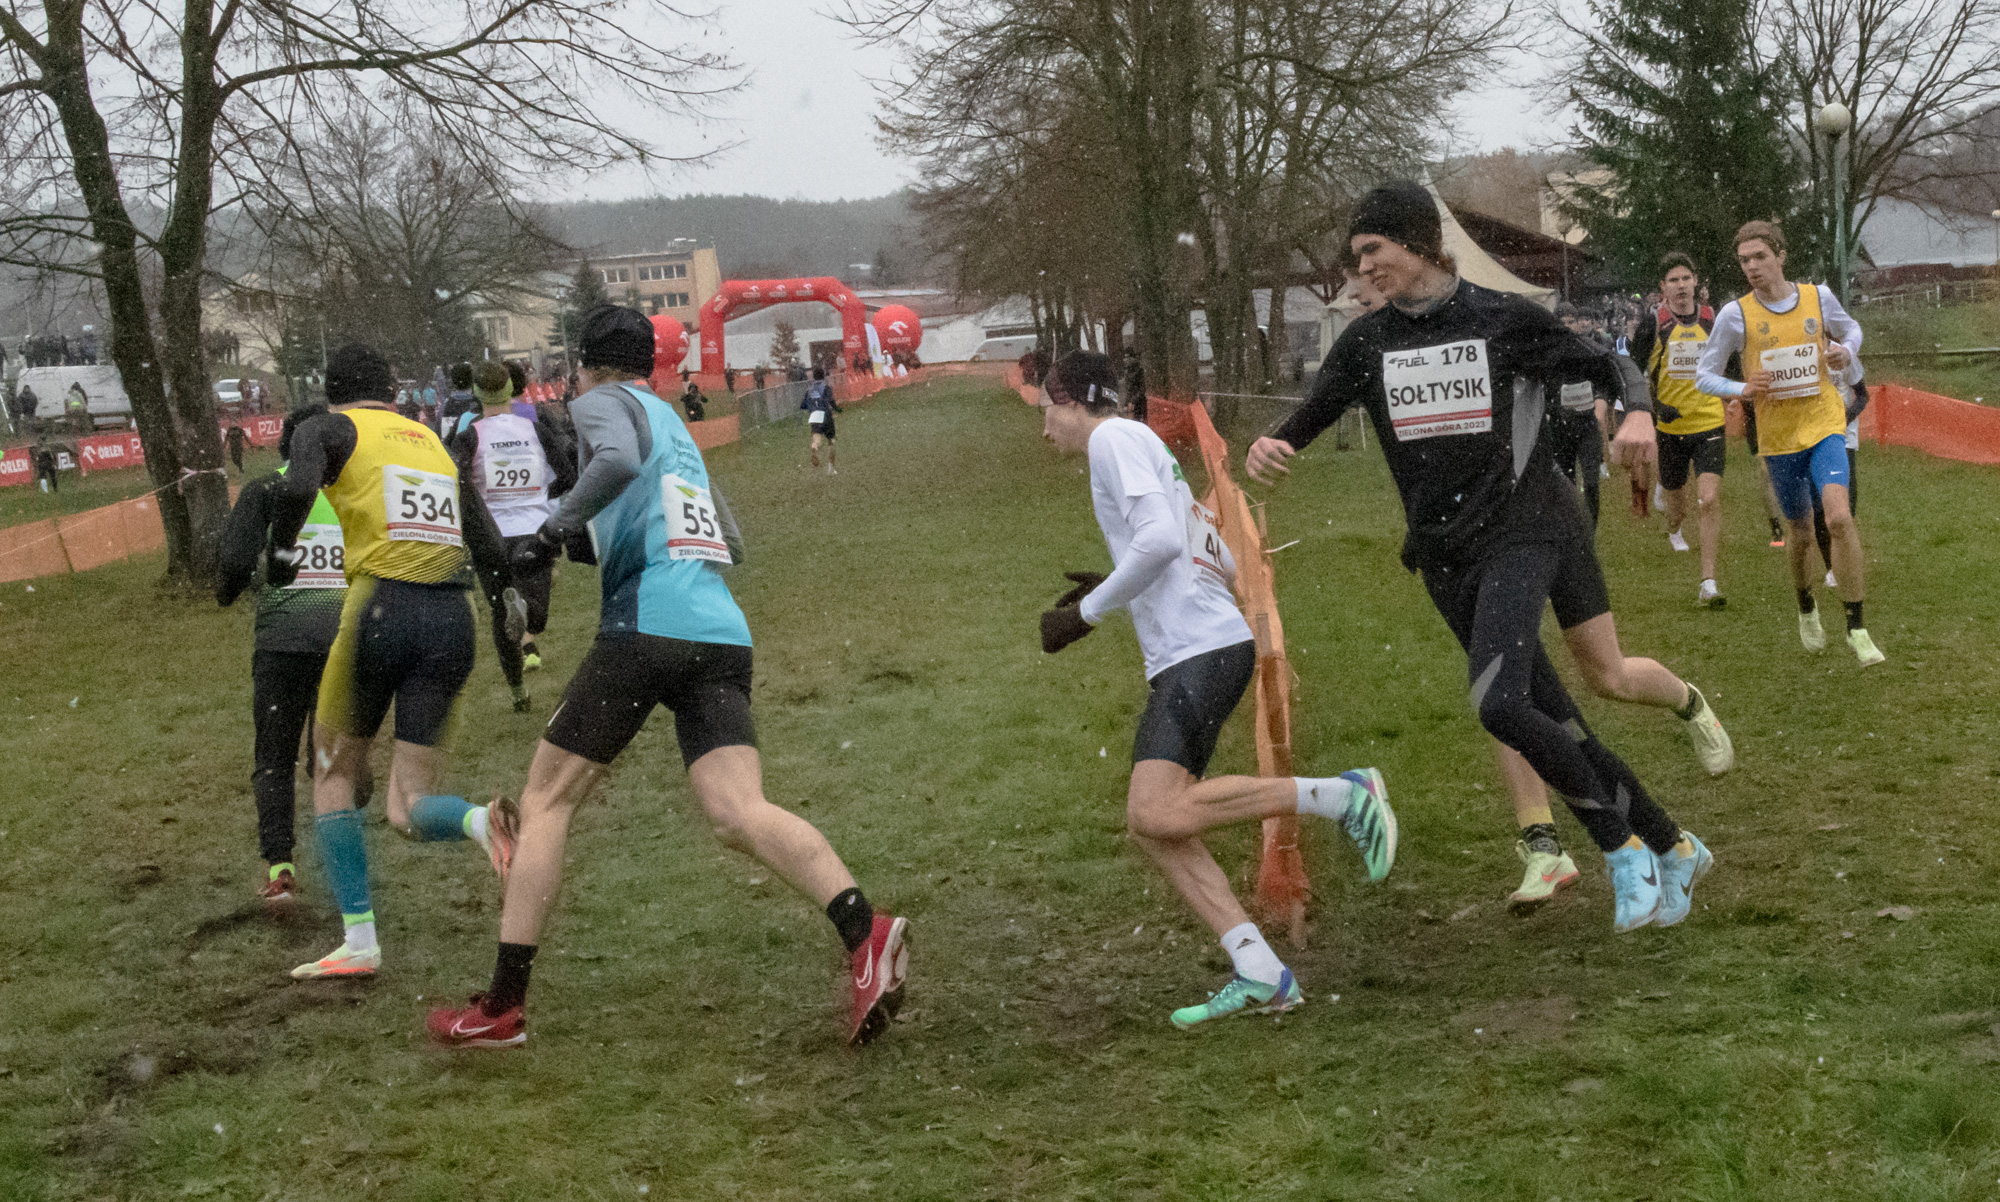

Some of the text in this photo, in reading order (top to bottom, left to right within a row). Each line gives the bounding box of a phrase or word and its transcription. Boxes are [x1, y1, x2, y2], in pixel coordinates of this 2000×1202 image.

[1441, 345, 1478, 366] 178
[1794, 346, 1814, 358] 467
[1672, 356, 1700, 367] GĘBIC
[1390, 378, 1486, 407] SOŁTYSIK
[1398, 420, 1486, 437] ZIELONA GÓRA 2023
[98, 444, 124, 460] ORLEN
[490, 440, 521, 449] TEMPO
[0, 458, 29, 475] ORLEN
[495, 468, 531, 488] 299
[401, 489, 455, 526] 534
[682, 501, 719, 539] 55
[392, 531, 426, 539] ZIELONA
[427, 533, 449, 542] GÓRA
[293, 544, 344, 571] 288
[678, 548, 711, 557] ZIELONA
[1205, 532, 1224, 569] 4
[316, 579, 338, 587] GÓRA
